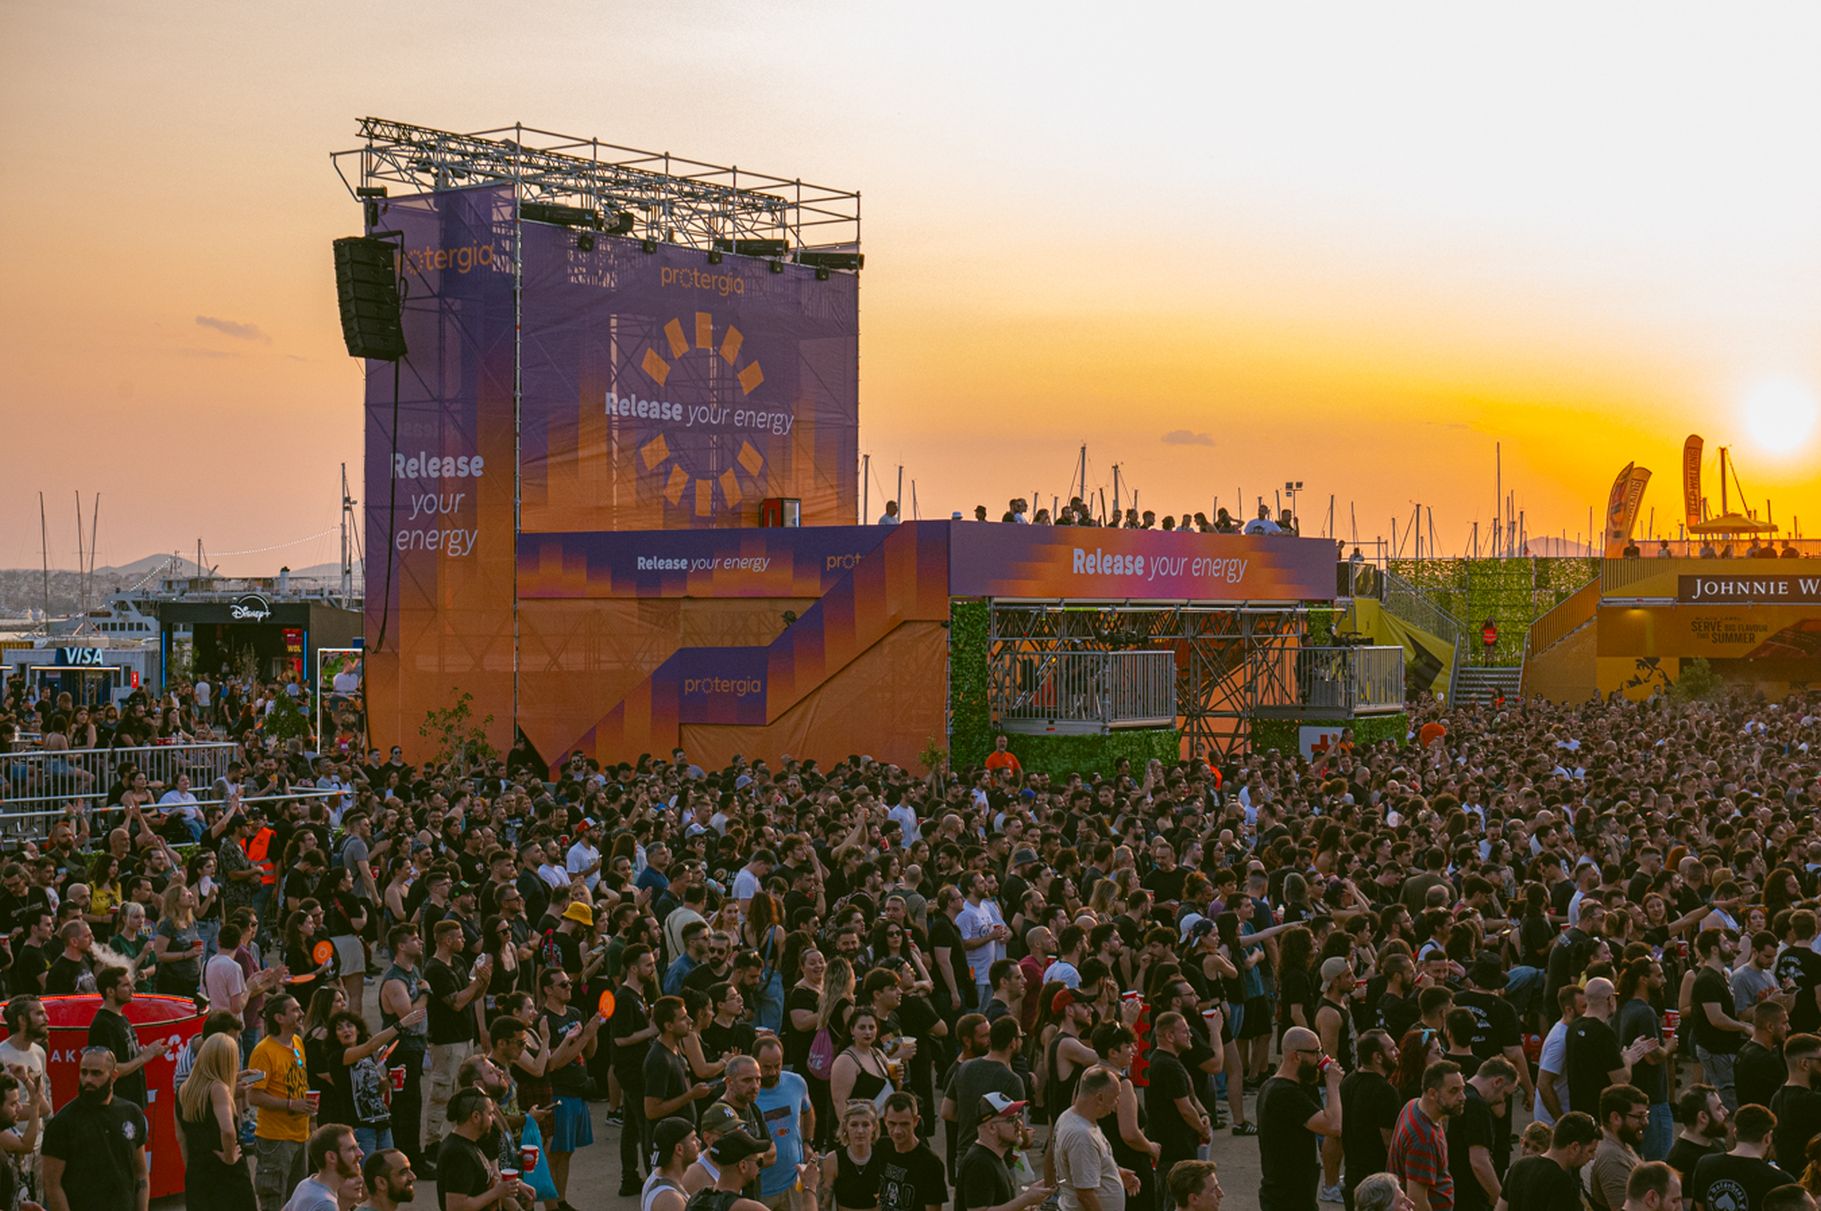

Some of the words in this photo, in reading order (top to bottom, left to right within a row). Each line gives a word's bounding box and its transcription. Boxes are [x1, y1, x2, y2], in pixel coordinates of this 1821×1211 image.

[661, 266, 745, 296] protergia
[605, 391, 682, 421] Release
[686, 405, 730, 427] your
[734, 408, 794, 435] energy
[390, 451, 484, 479] Release
[408, 493, 465, 520] your
[396, 529, 478, 556] energy
[637, 556, 687, 570] Release
[690, 557, 720, 573] your
[723, 557, 770, 573] energy
[1073, 548, 1144, 576] Release
[1148, 555, 1188, 582] your
[1191, 557, 1248, 583] energy
[1798, 578, 1821, 596] W
[1691, 621, 1722, 632] SERVE
[1712, 632, 1755, 643] SUMMER
[64, 647, 104, 665] VISA
[684, 676, 761, 697] protergia
